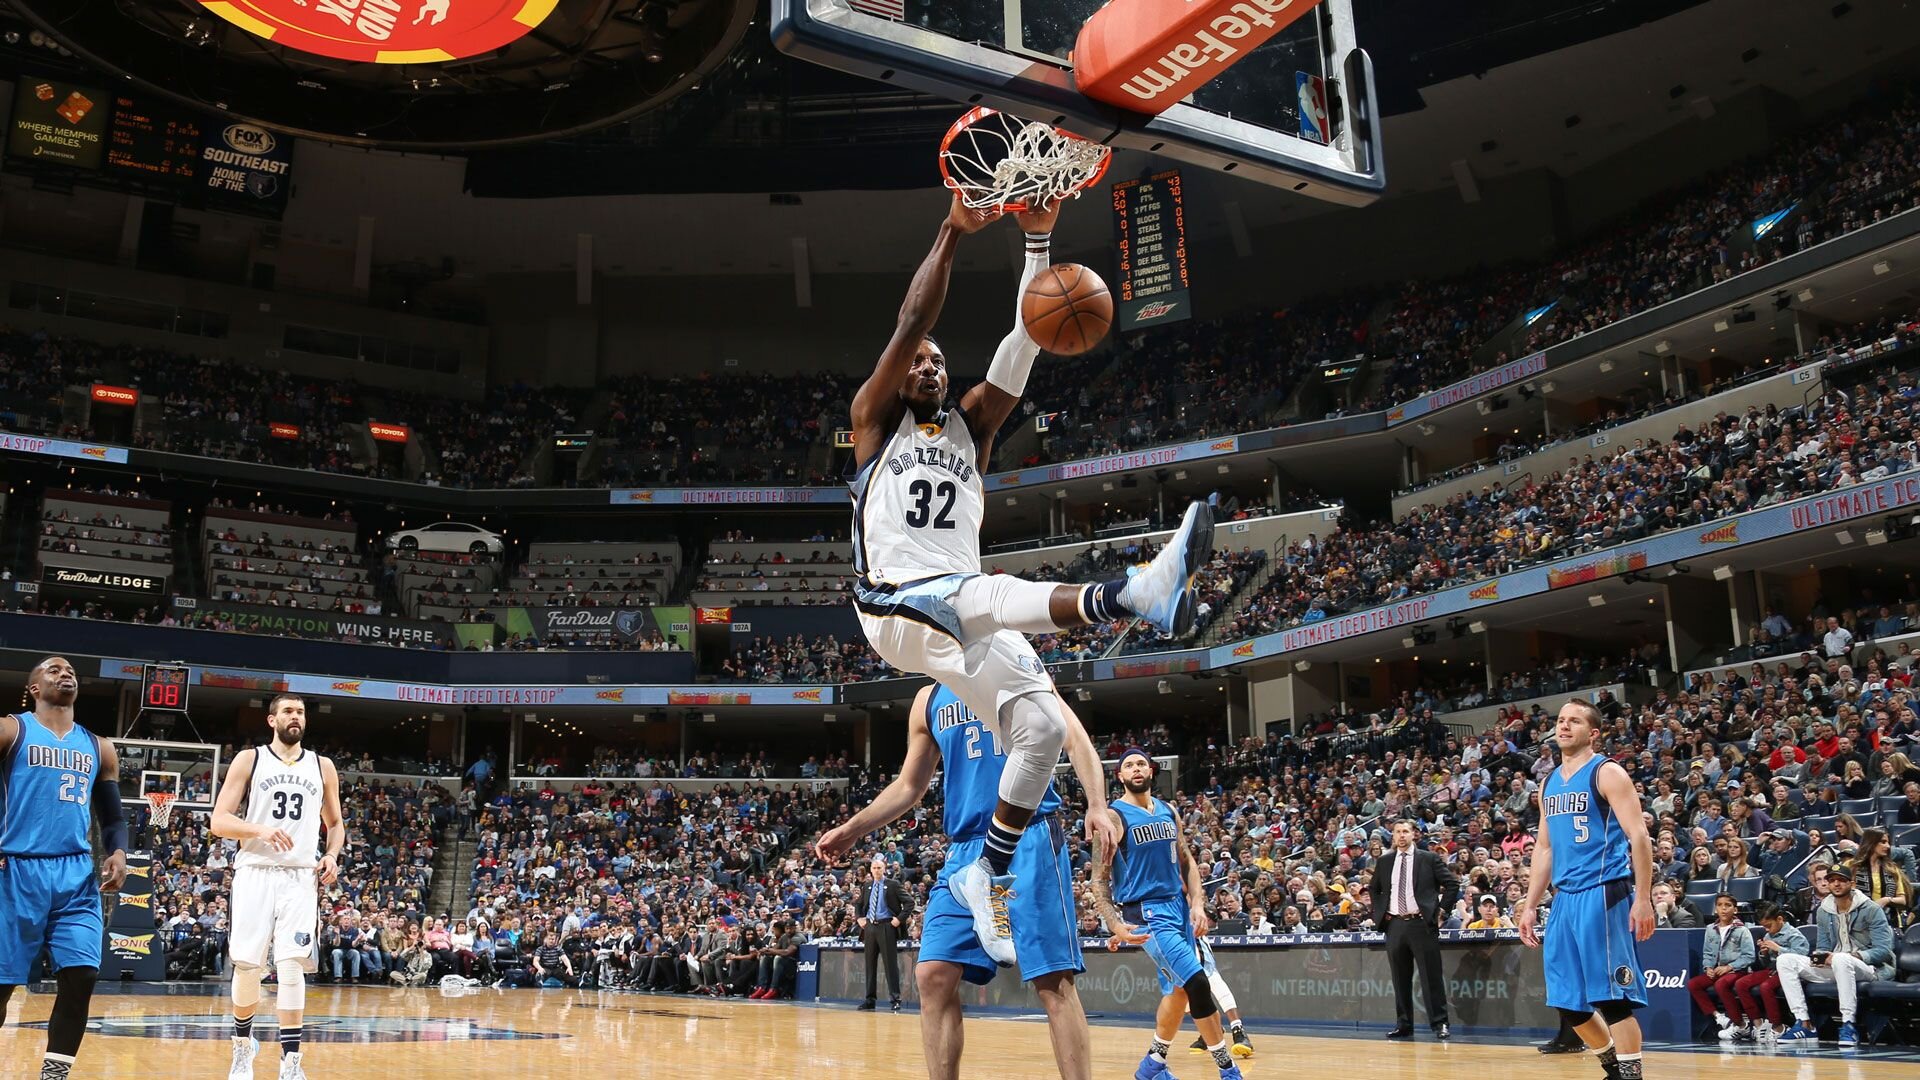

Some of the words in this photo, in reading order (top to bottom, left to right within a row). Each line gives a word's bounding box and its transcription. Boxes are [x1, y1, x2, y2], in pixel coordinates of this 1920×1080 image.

[18, 120, 53, 134] WHERE
[55, 127, 99, 142] MEMPHIS
[234, 128, 264, 145] FOX
[33, 132, 82, 148] GAMBLES.
[203, 147, 289, 175] SOUTHEAST
[212, 166, 246, 182] HOME
[208, 177, 223, 187] OF
[225, 179, 246, 193] THE
[1136, 213, 1161, 225] BLOCKS
[1137, 223, 1161, 234] STEALS
[1137, 233, 1163, 245] ASSISTS
[1134, 262, 1170, 277] TURNOVERS
[1134, 278, 1146, 288] PTS
[1154, 273, 1172, 284] PAINT
[1799, 370, 1810, 381] C5
[1429, 381, 1475, 410] ULTIMATE
[1479, 371, 1503, 392] ICED
[1505, 365, 1526, 381] TEA
[107, 391, 134, 400] TOYOTA
[275, 427, 298, 435] TOYOTA
[380, 429, 405, 437] TOYOTA
[15, 437, 45, 452] STOP
[81, 447, 106, 456] SONIC
[1210, 441, 1233, 451] SONIC
[887, 446, 974, 483] GRIZZLIES
[1049, 463, 1096, 481] ULTIMATE
[1100, 458, 1124, 472] ICED
[1128, 454, 1147, 468] TEA
[1150, 449, 1177, 465] STOP
[683, 490, 733, 503] ULTIMATE
[735, 490, 761, 503] ICED
[765, 490, 784, 502] TEA
[787, 490, 813, 502] STOP
[1790, 485, 1888, 530] ULTIMATE
[1893, 477, 1920, 506] IC
[905, 479, 957, 530] 32
[1700, 524, 1738, 545] SONIC
[56, 570, 102, 584] FanDuel
[104, 576, 152, 589] LEDGE
[18, 583, 37, 592] 110A
[1468, 584, 1499, 601] SONIC
[547, 611, 615, 626] FanDuel
[1283, 623, 1336, 650] ULTIMATE
[1339, 614, 1368, 637] ICED
[1371, 608, 1394, 630] TEA
[1398, 600, 1430, 624] STOP
[336, 622, 382, 638] WINS
[388, 627, 434, 643] HERE
[1232, 642, 1255, 657] SONIC
[121, 665, 142, 675] SON
[332, 682, 360, 692] SONIC
[150, 684, 178, 706] 08
[398, 686, 457, 703] ULTIMATE
[463, 688, 492, 704] ICED
[498, 690, 520, 704] TEA
[523, 688, 556, 704] STOP
[596, 691, 623, 699] SONIC
[793, 691, 821, 699] SONIC
[937, 700, 979, 734] DALL
[28, 744, 94, 775] DALLAS
[60, 773, 90, 806] 23
[259, 774, 318, 797] GRIZZLIES
[272, 790, 304, 821] 33
[1544, 791, 1589, 819] DALLAS
[1573, 815, 1590, 843] 5
[121, 896, 149, 905] SONIC
[1220, 936, 1241, 944] FanDuel
[1246, 936, 1268, 945] FanDuel
[1272, 935, 1295, 944] FanDuel
[1300, 935, 1324, 943] FanDuel
[1329, 934, 1353, 943] FanDuel
[1360, 932, 1386, 941] FanDuel
[1458, 930, 1486, 940] FanDuel
[112, 938, 151, 950] SONIC
[1643, 969, 1687, 988] Duel
[1271, 978, 1395, 998] INTERNATIONA
[1450, 979, 1510, 999] PAPER
